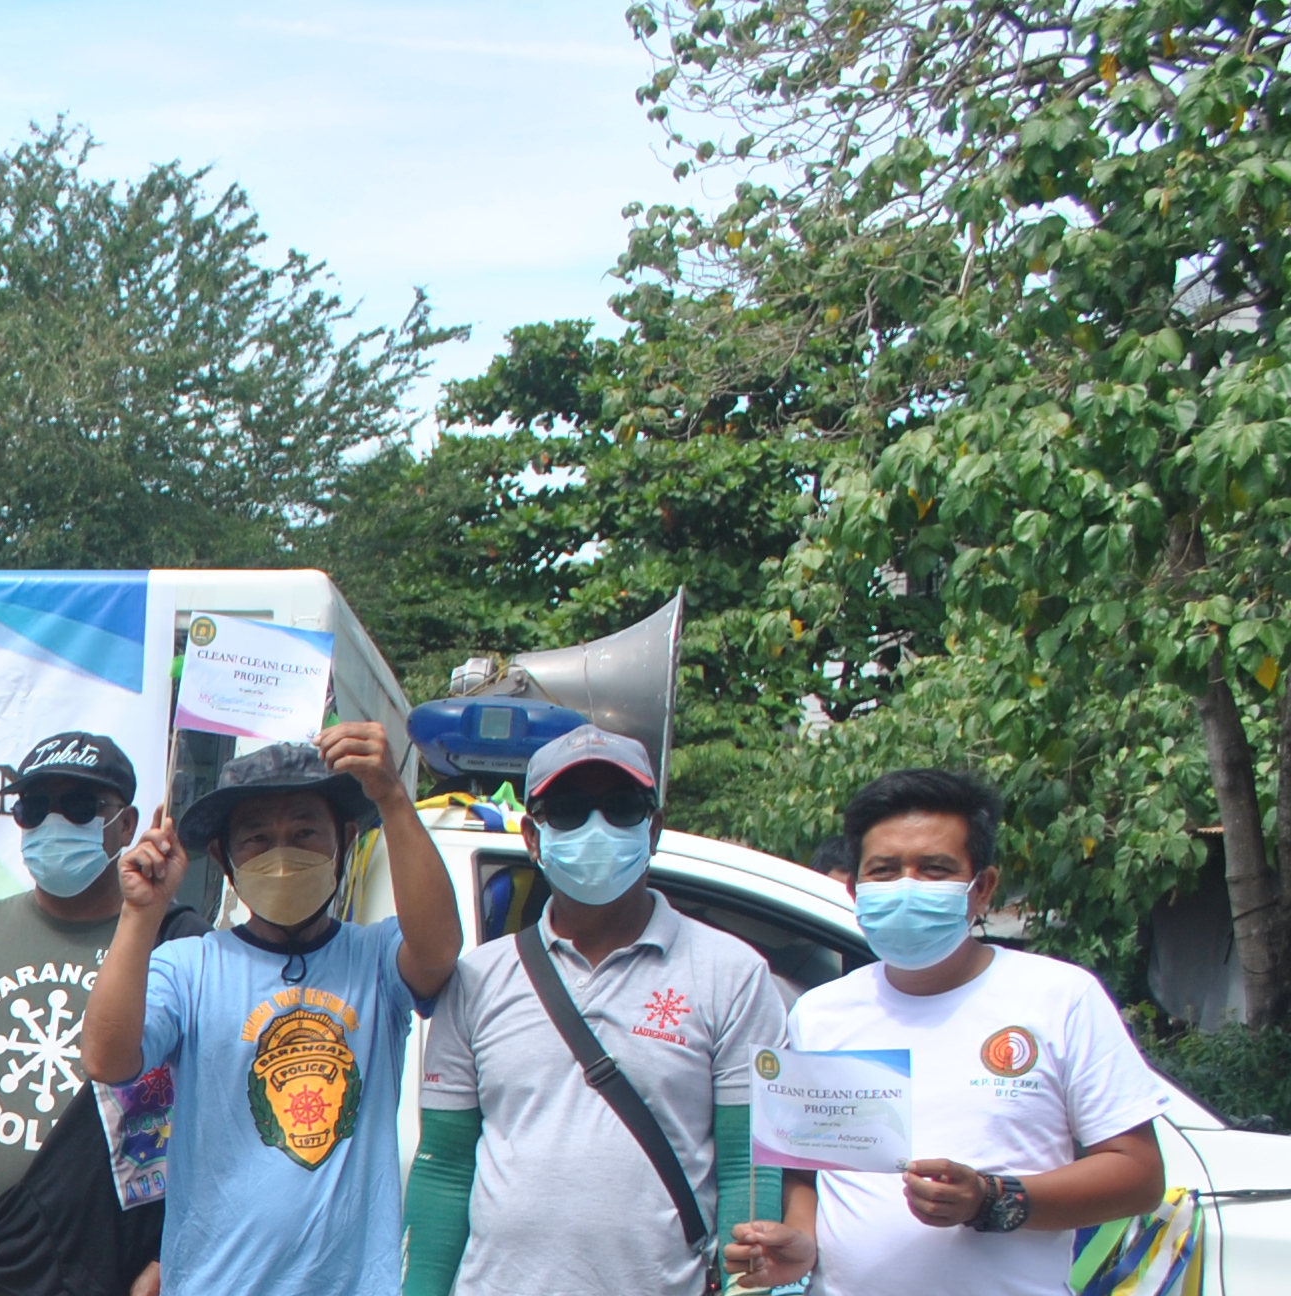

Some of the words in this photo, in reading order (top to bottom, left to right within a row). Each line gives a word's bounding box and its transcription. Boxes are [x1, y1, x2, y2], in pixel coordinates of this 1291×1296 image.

[197, 649, 238, 664] CLEAN!
[239, 655, 279, 671] CLEAN!
[281, 663, 322, 677] CLEAN!
[233, 670, 280, 686] PROJECT
[259, 1044, 347, 1067] BARANGAY
[280, 1061, 329, 1079] POLICE
[767, 1084, 804, 1097] CLEAN!
[807, 1089, 852, 1099] CLEAN!
[855, 1089, 902, 1099] CLEAN!
[804, 1104, 857, 1117] PROJECT
[297, 1137, 322, 1146] 1977
[837, 1133, 878, 1144] Advocacy
